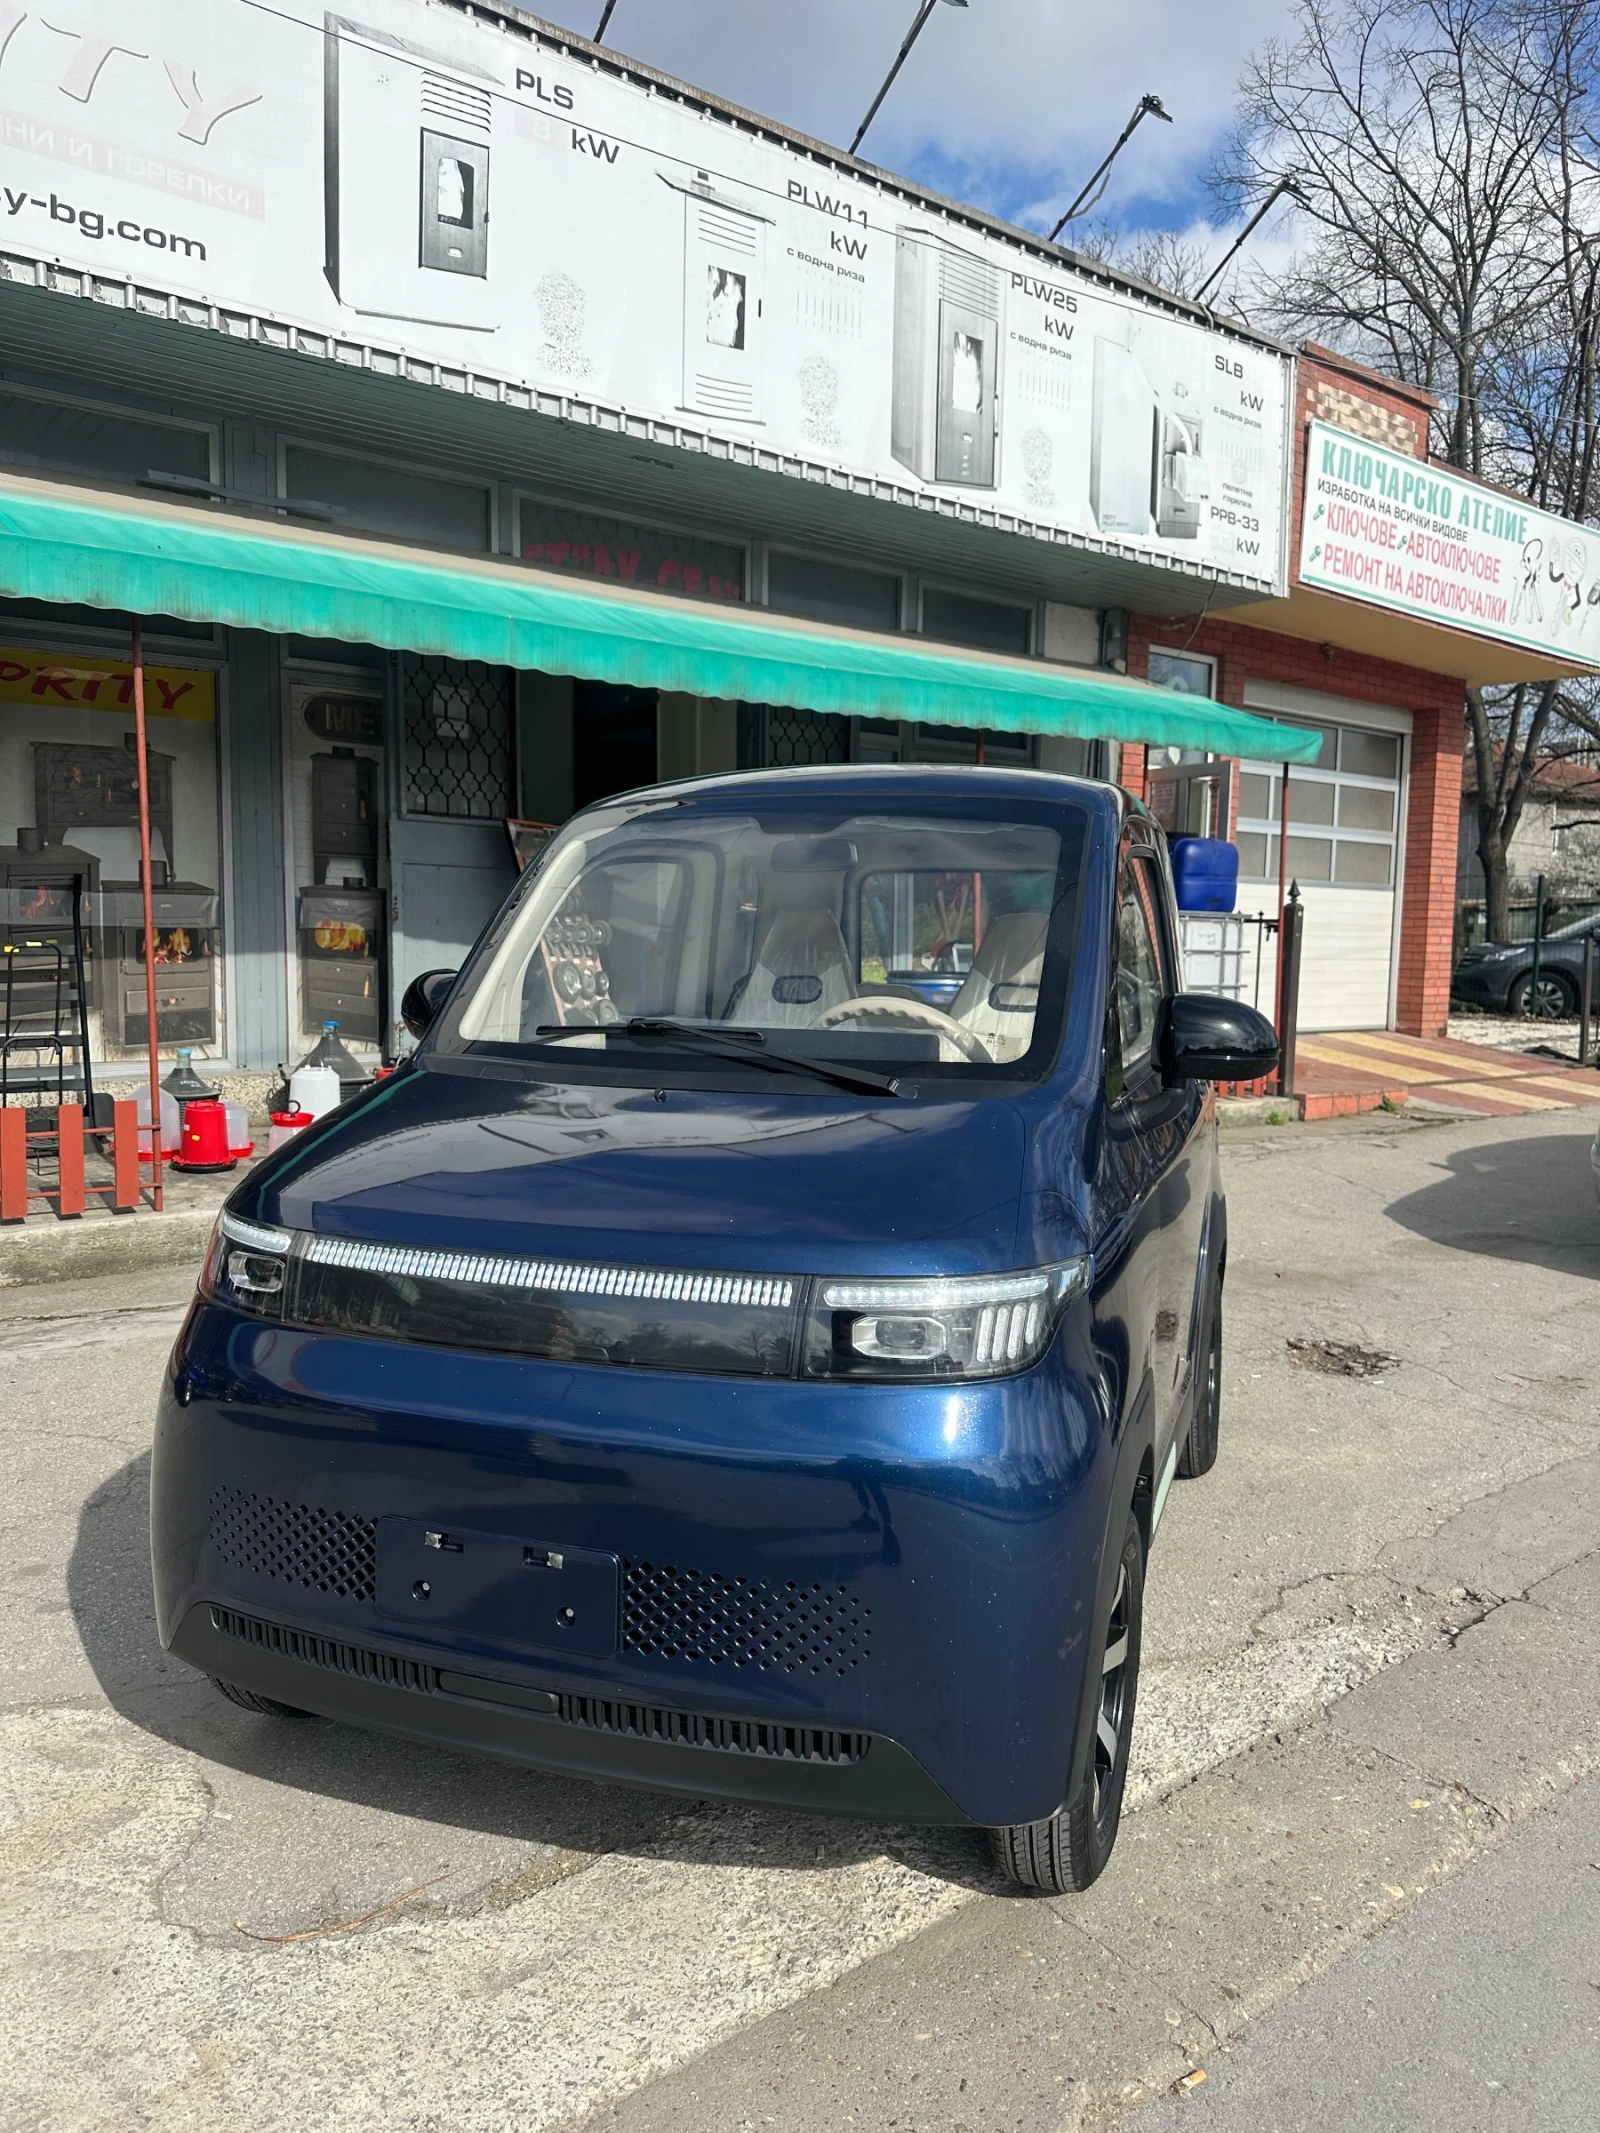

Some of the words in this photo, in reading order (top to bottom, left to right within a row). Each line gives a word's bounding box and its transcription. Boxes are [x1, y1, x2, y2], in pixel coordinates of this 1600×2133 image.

[516, 67, 574, 110] PLS
[571, 128, 620, 164] kW
[69, 138, 94, 164] И
[107, 147, 250, 212] ГОРЕЛКИ
[787, 178, 867, 229] PLW11
[831, 230, 868, 260] kW
[786, 247, 794, 256] с
[797, 251, 834, 271] водна
[837, 266, 865, 283] риза
[1011, 272, 1078, 314] PLW25
[1044, 314, 1074, 340] kW
[1018, 334, 1047, 351] водна
[1049, 346, 1072, 360] риза
[1214, 354, 1243, 379] SLB
[1240, 390, 1264, 412] kW
[1321, 438, 1452, 520] КЛЮЧАРСКО
[1457, 494, 1528, 545] АТЕЛИЕ
[1210, 506, 1260, 532] PPB-33
[1317, 478, 1376, 511] ИЗРАБОТКА
[1378, 500, 1392, 516] НА
[1394, 506, 1431, 531] ВСИЧКИ
[1432, 520, 1468, 543] ВИДОВЕ
[1236, 537, 1260, 556] kW
[1327, 501, 1398, 550] КЛЮЧОВЕ
[1406, 530, 1501, 584] АВТОКЛЮЧОВЕ
[1323, 543, 1383, 587] РЕМОНТ
[1384, 562, 1403, 594] НА
[1405, 570, 1507, 625] АВТОКЛЮЧАЛКИ
